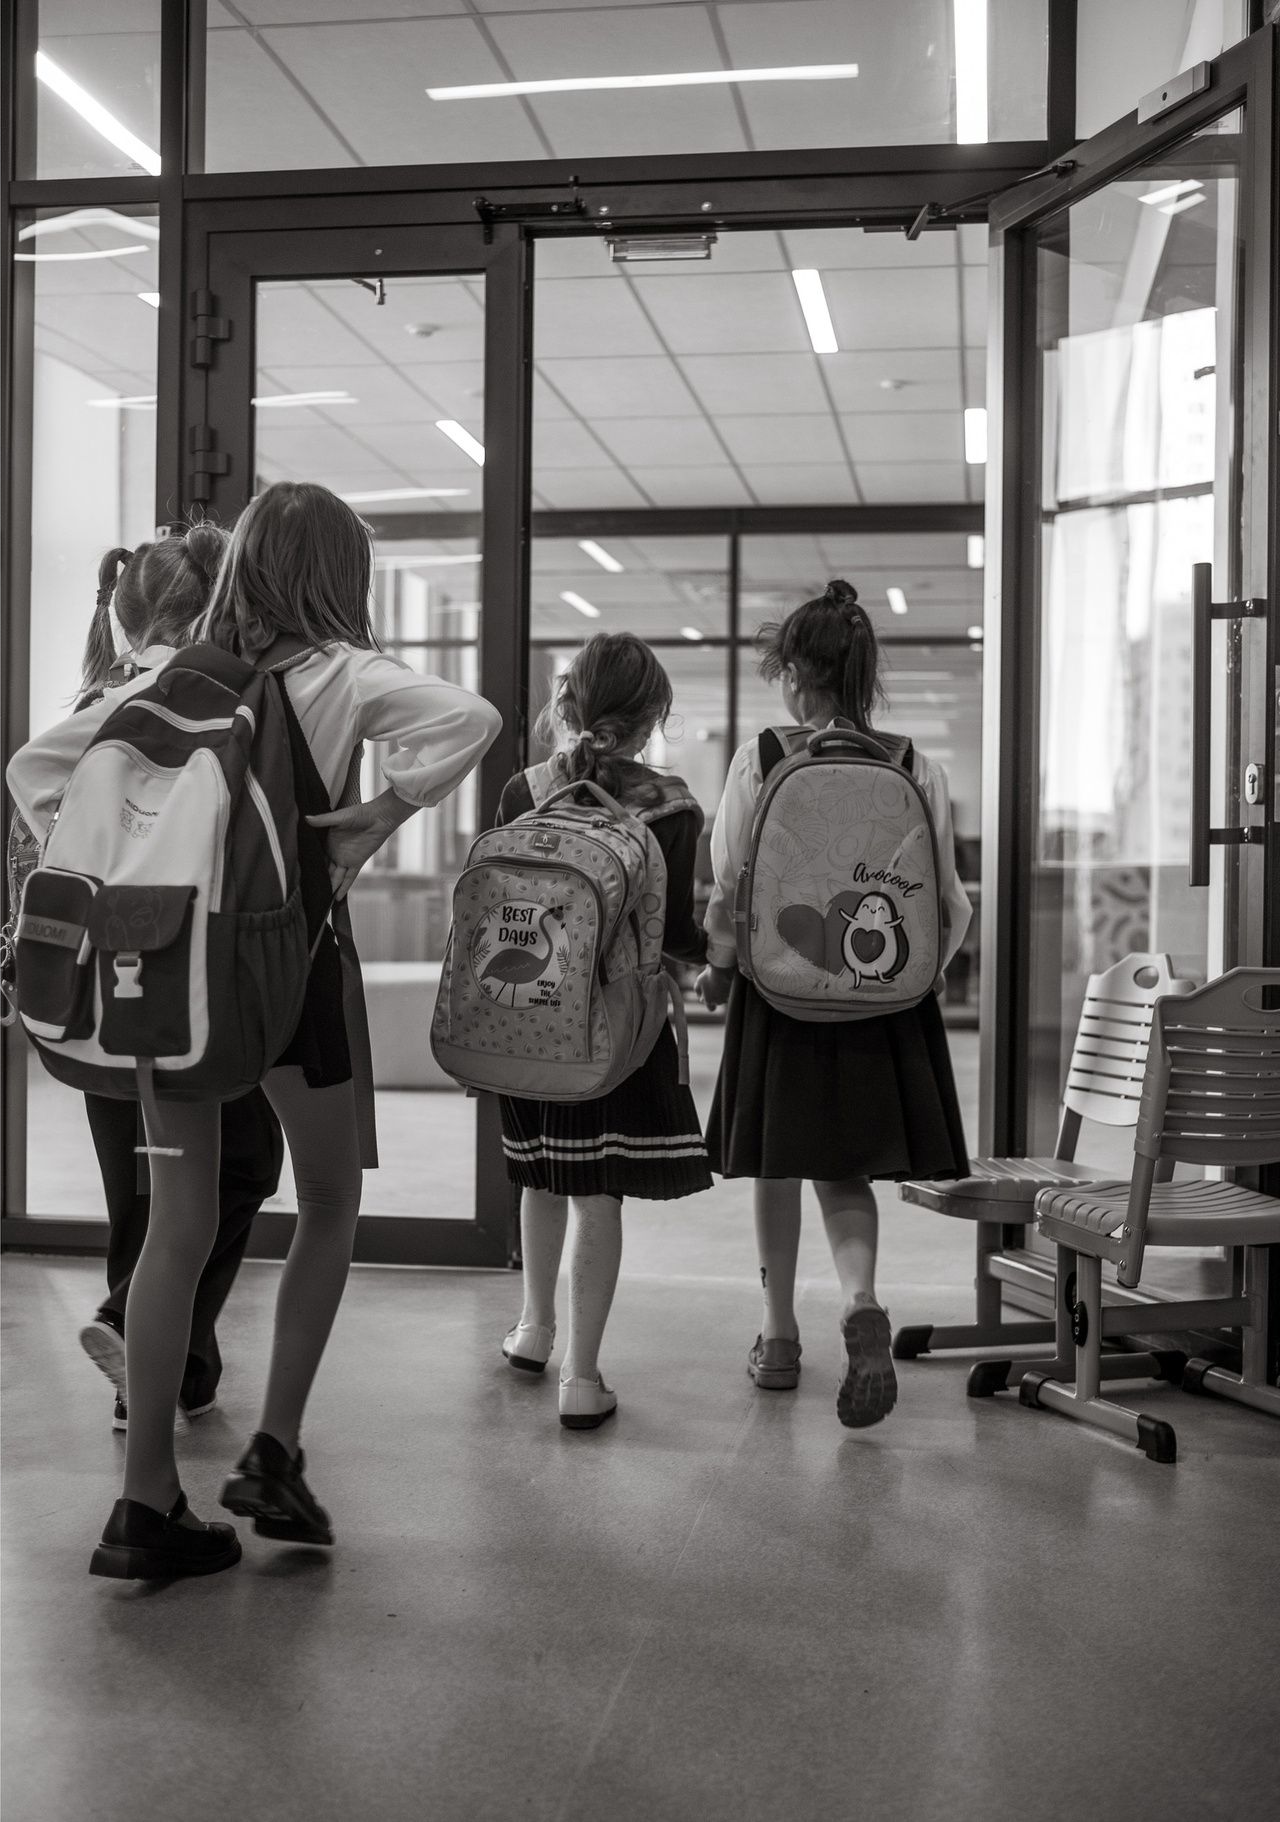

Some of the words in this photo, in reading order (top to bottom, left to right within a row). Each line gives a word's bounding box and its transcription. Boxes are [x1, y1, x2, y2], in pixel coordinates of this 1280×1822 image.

[853, 862, 923, 898] Avocool
[502, 906, 537, 925] BEST
[499, 927, 538, 947] DAYS
